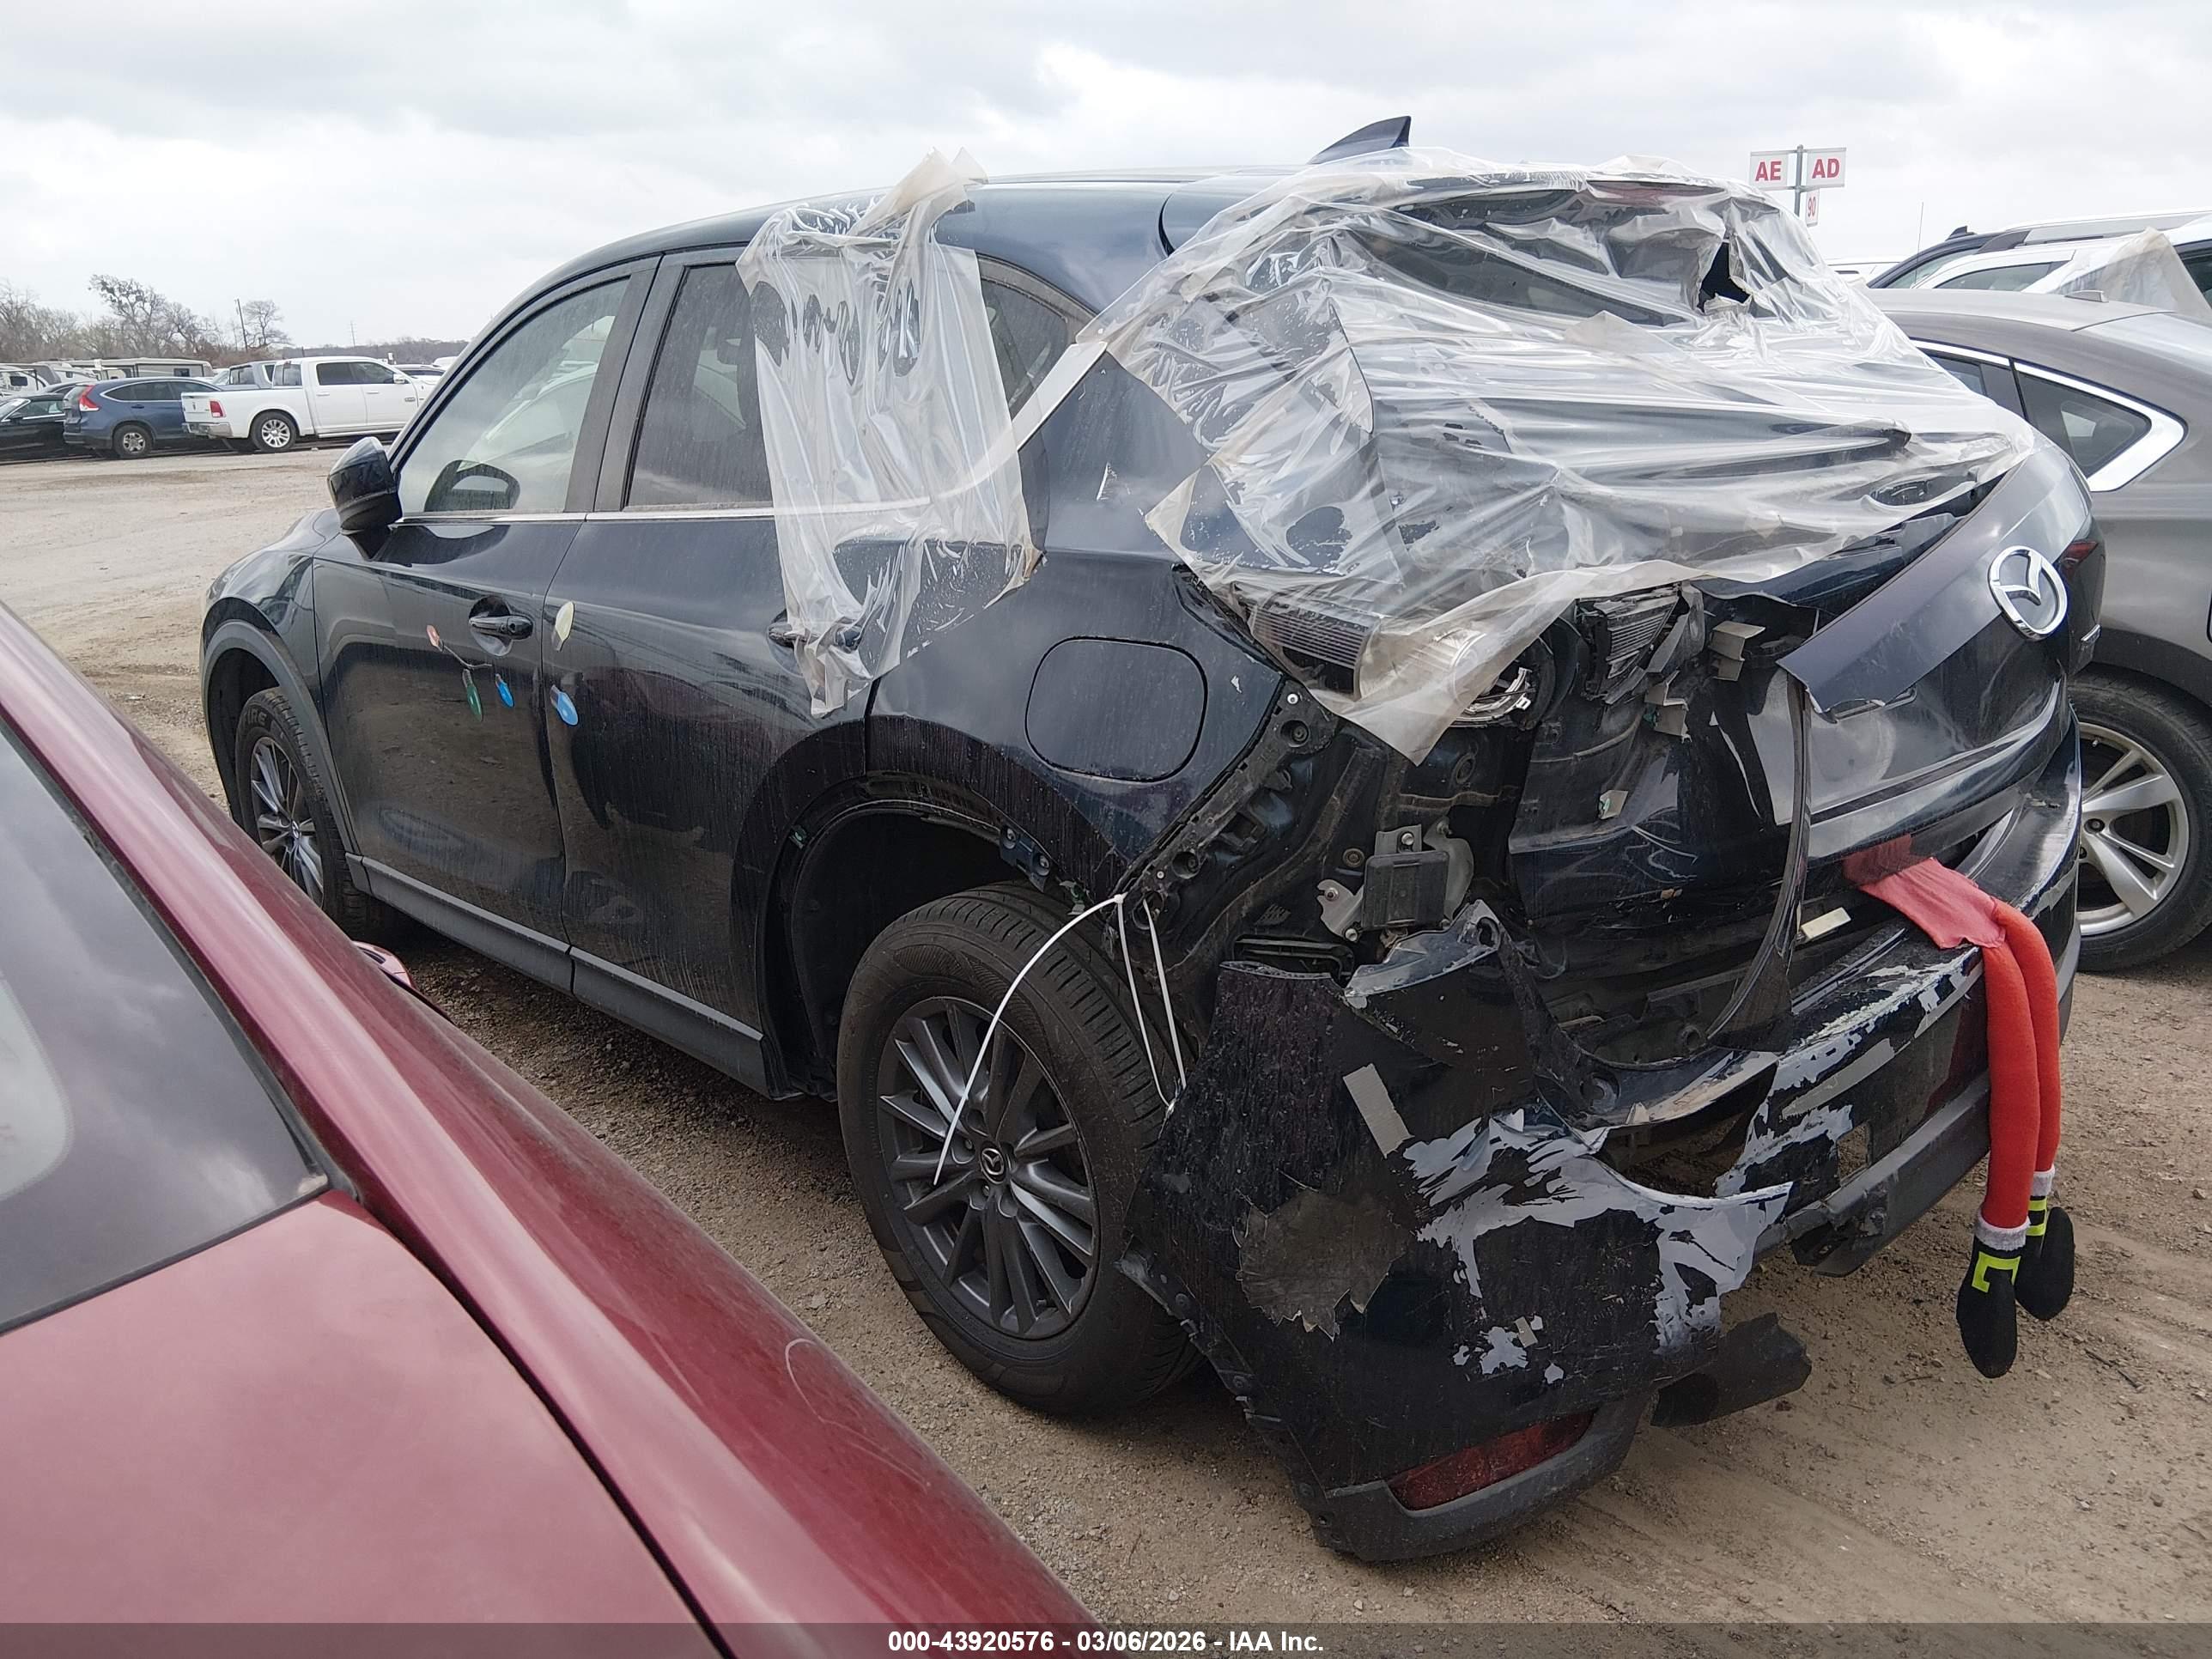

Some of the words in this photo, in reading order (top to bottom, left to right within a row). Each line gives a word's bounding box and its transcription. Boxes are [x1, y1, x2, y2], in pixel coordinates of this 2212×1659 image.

[1754, 161, 1782, 181] AE
[1812, 158, 1840, 179] AD
[1808, 197, 1816, 217] 90
